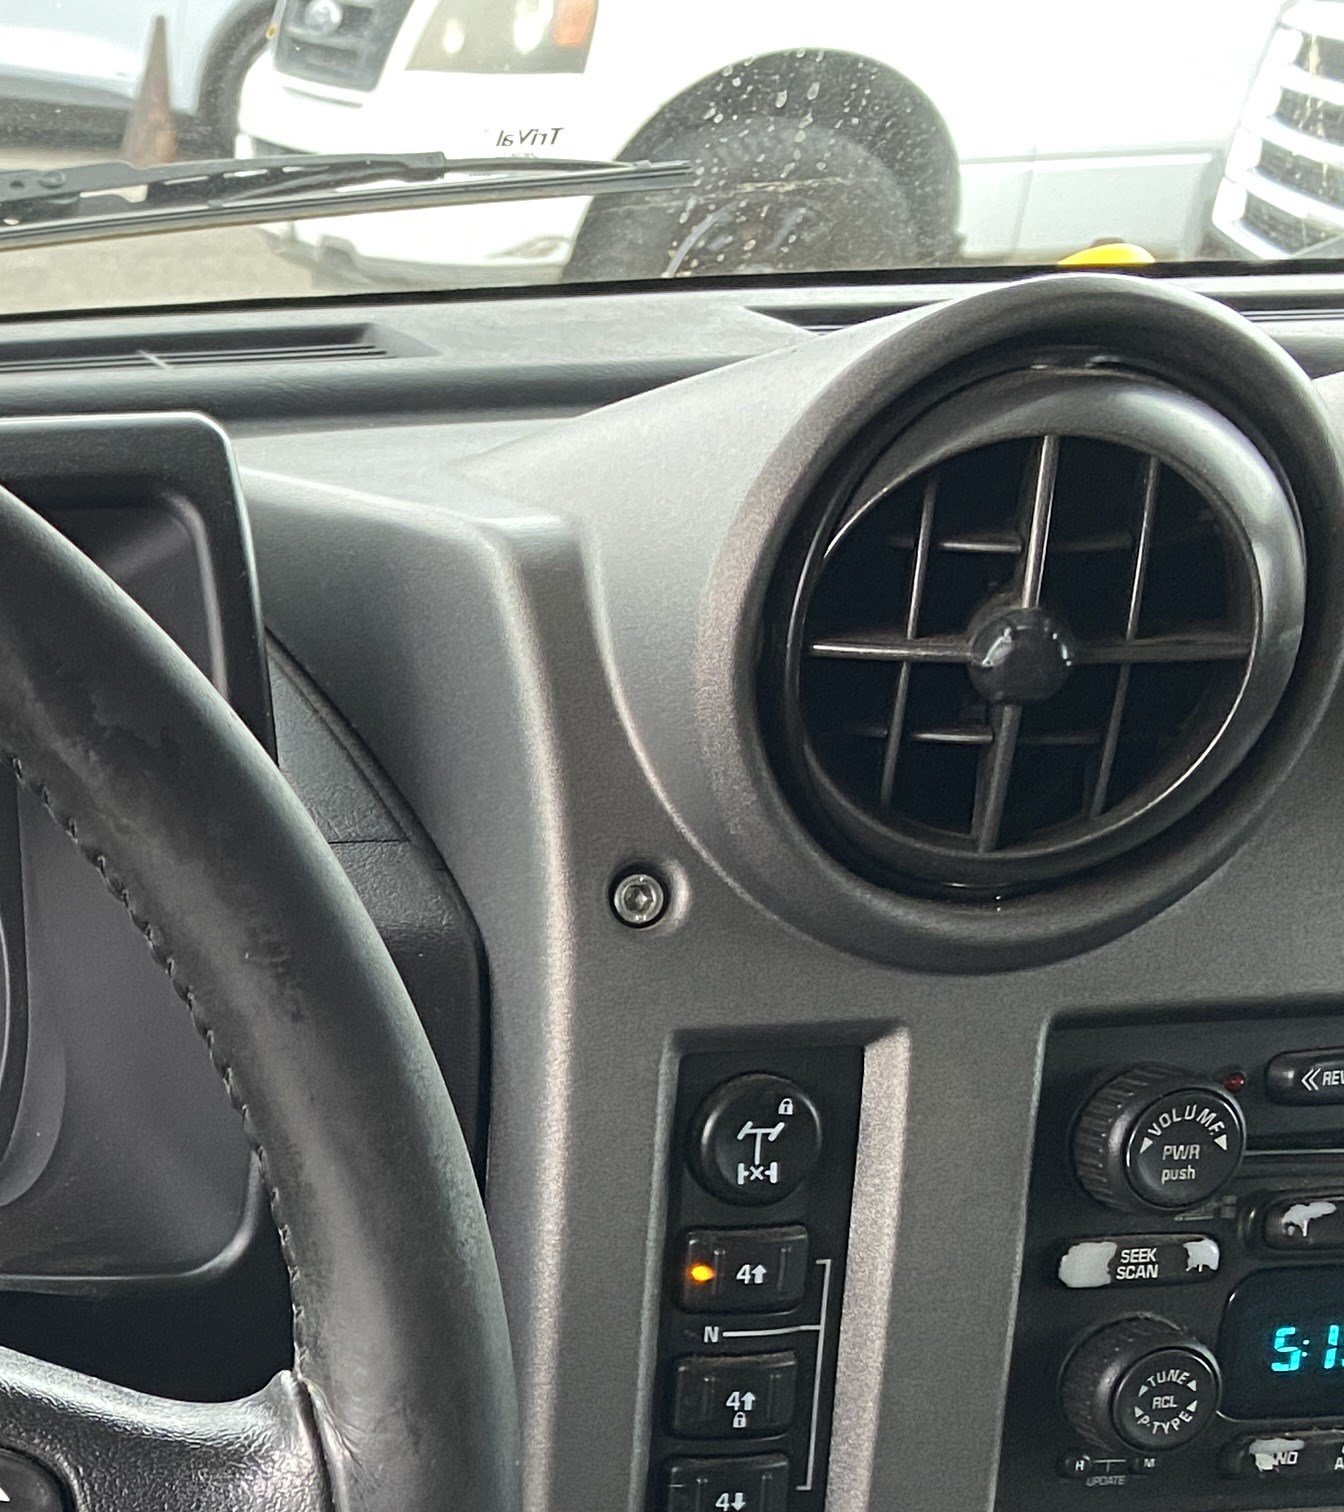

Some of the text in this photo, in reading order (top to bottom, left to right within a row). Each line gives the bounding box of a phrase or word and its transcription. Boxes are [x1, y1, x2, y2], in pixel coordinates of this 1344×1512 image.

[1147, 1104, 1225, 1136] VOLUME
[1162, 1144, 1200, 1160] PWR
[1161, 1164, 1196, 1185] push
[1120, 1248, 1157, 1264] SEEK
[736, 1265, 752, 1284] 4
[1116, 1265, 1159, 1281] SCAN
[703, 1326, 720, 1343] N
[1270, 1324, 1344, 1373] 5:1
[1147, 1369, 1191, 1387] TUNE
[726, 1392, 742, 1411] 4
[1152, 1396, 1178, 1409] RCL
[1137, 1411, 1193, 1434] P.TYPE
[1086, 1475, 1126, 1487] UPDATE
[715, 1493, 732, 1512] 4
